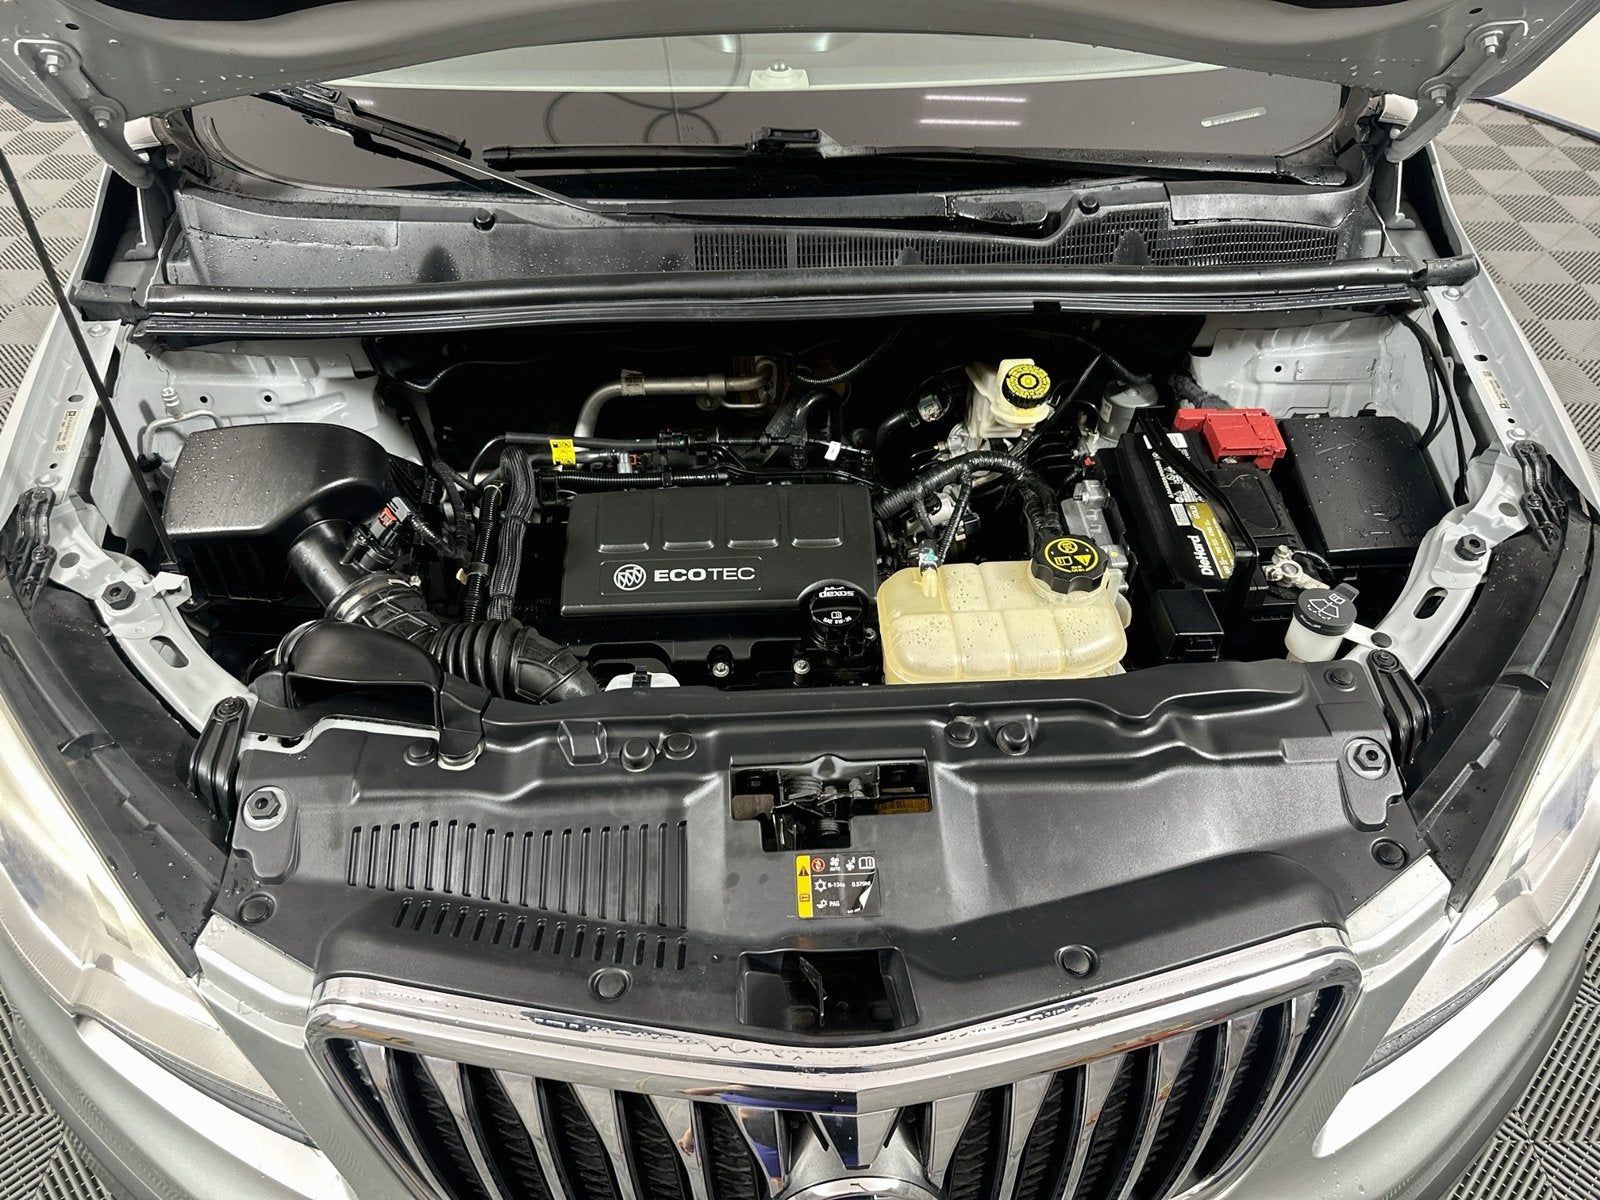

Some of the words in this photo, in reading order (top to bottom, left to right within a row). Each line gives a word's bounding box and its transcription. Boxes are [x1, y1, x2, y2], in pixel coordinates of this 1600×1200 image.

[1186, 534, 1215, 576] DieHard
[654, 567, 755, 582] ECOTEC
[818, 589, 855, 598] dexos
[828, 900, 841, 908] PAG
